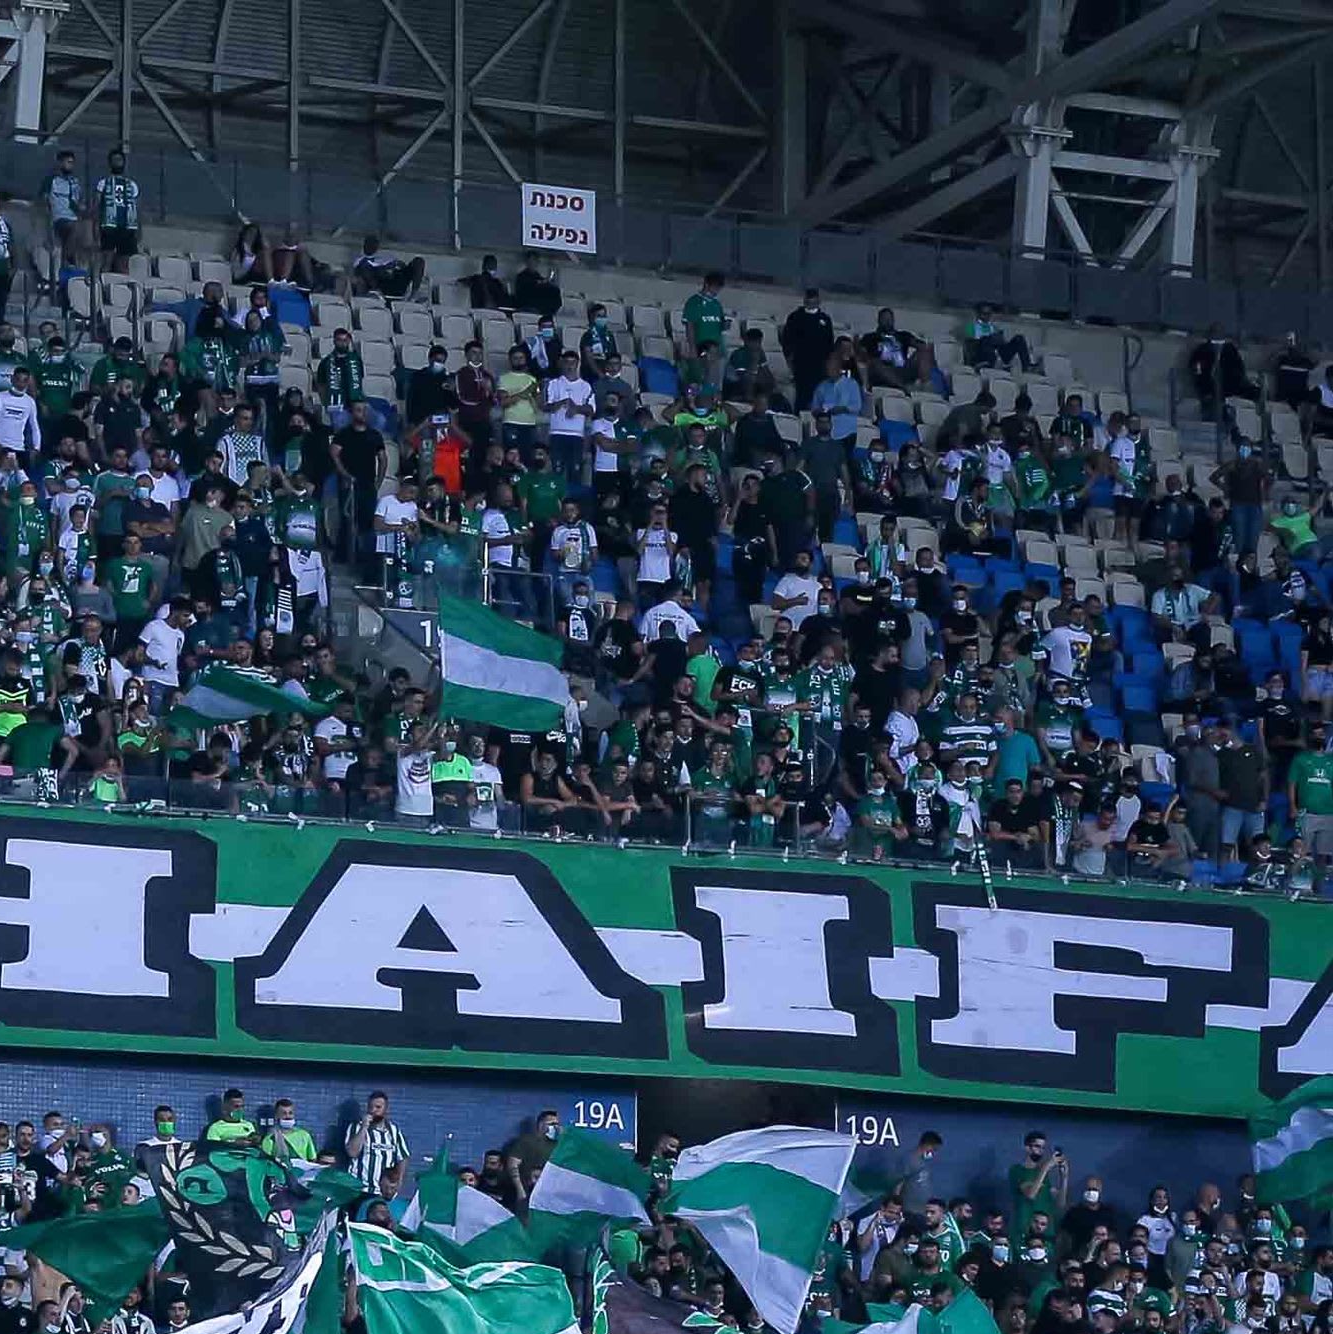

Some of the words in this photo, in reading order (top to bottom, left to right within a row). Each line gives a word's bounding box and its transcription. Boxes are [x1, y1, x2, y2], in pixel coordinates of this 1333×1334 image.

[530, 191, 585, 213] סכנת
[530, 222, 589, 247] נפילה
[572, 1099, 625, 1131] 19A
[844, 1113, 901, 1148] 19A
[94, 1162, 128, 1175] VOLVO
